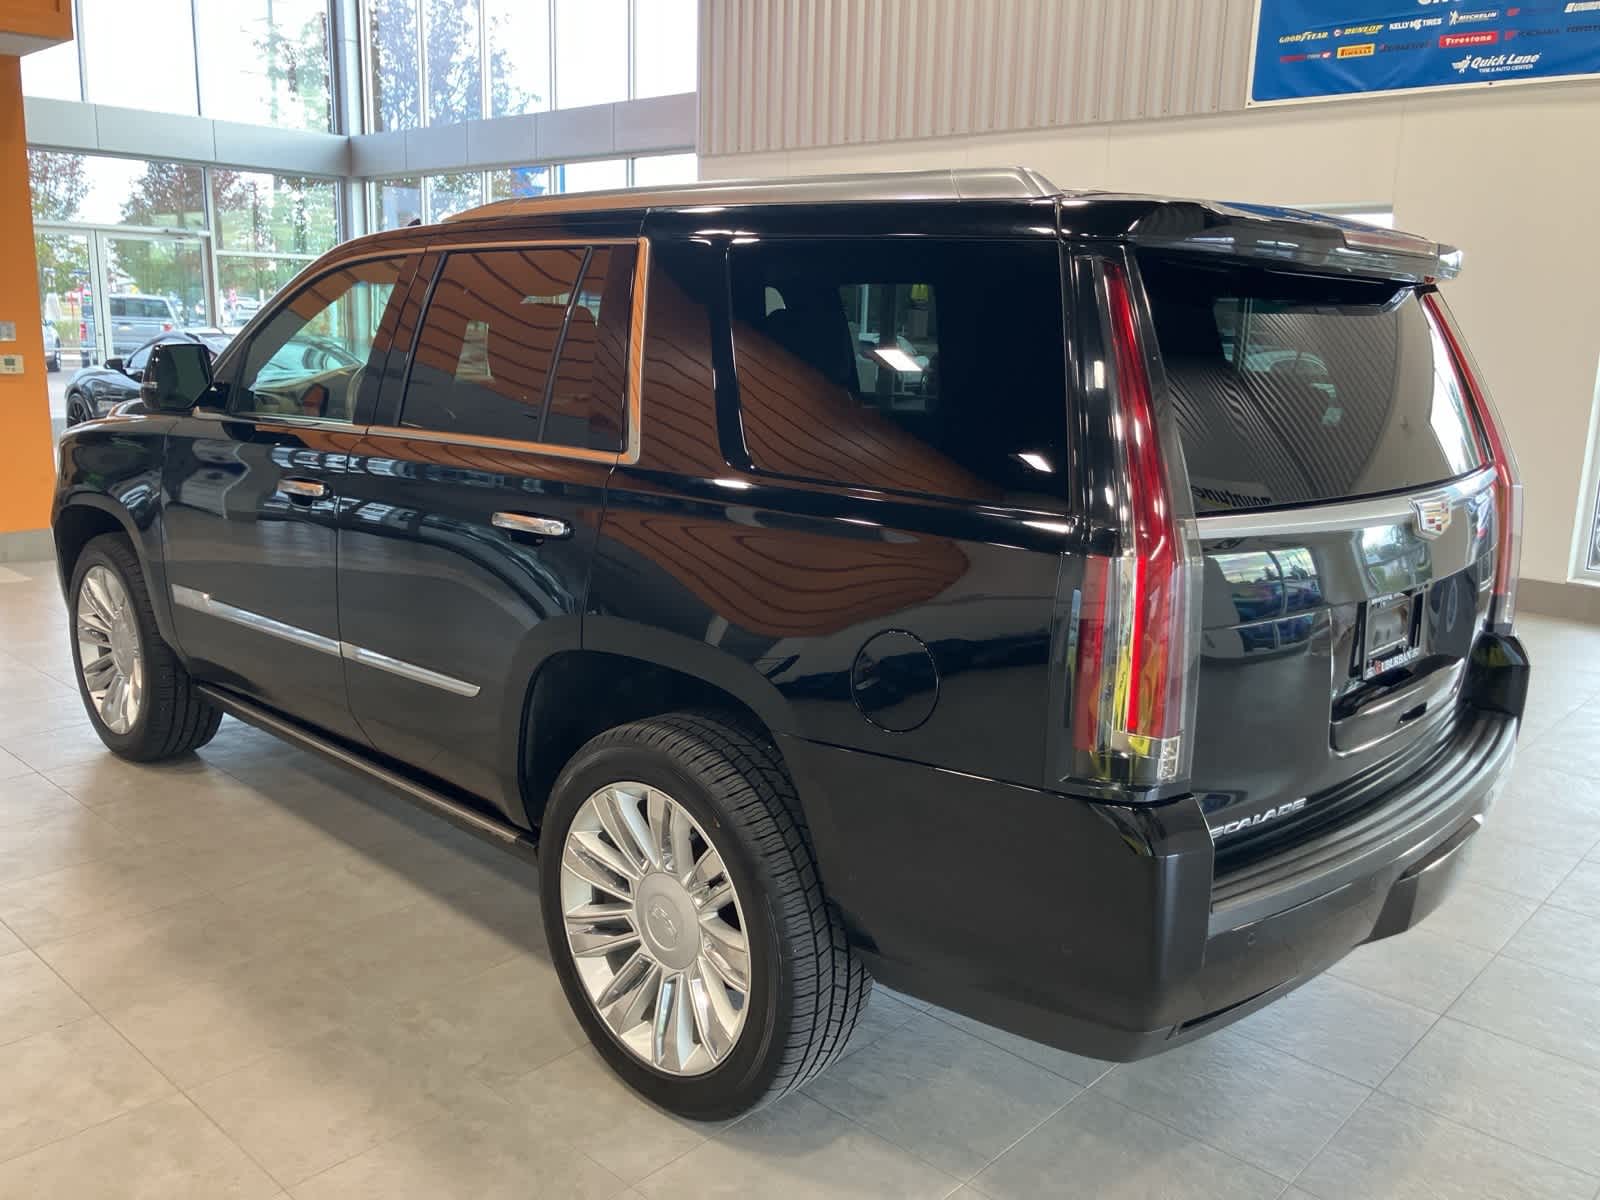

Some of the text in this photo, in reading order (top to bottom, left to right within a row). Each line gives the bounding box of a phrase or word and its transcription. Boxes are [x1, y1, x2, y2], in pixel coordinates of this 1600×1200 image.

[1445, 35, 1492, 46] Firestone
[1471, 53, 1540, 69] Quick Lane
[1209, 797, 1307, 839] SCALADE
